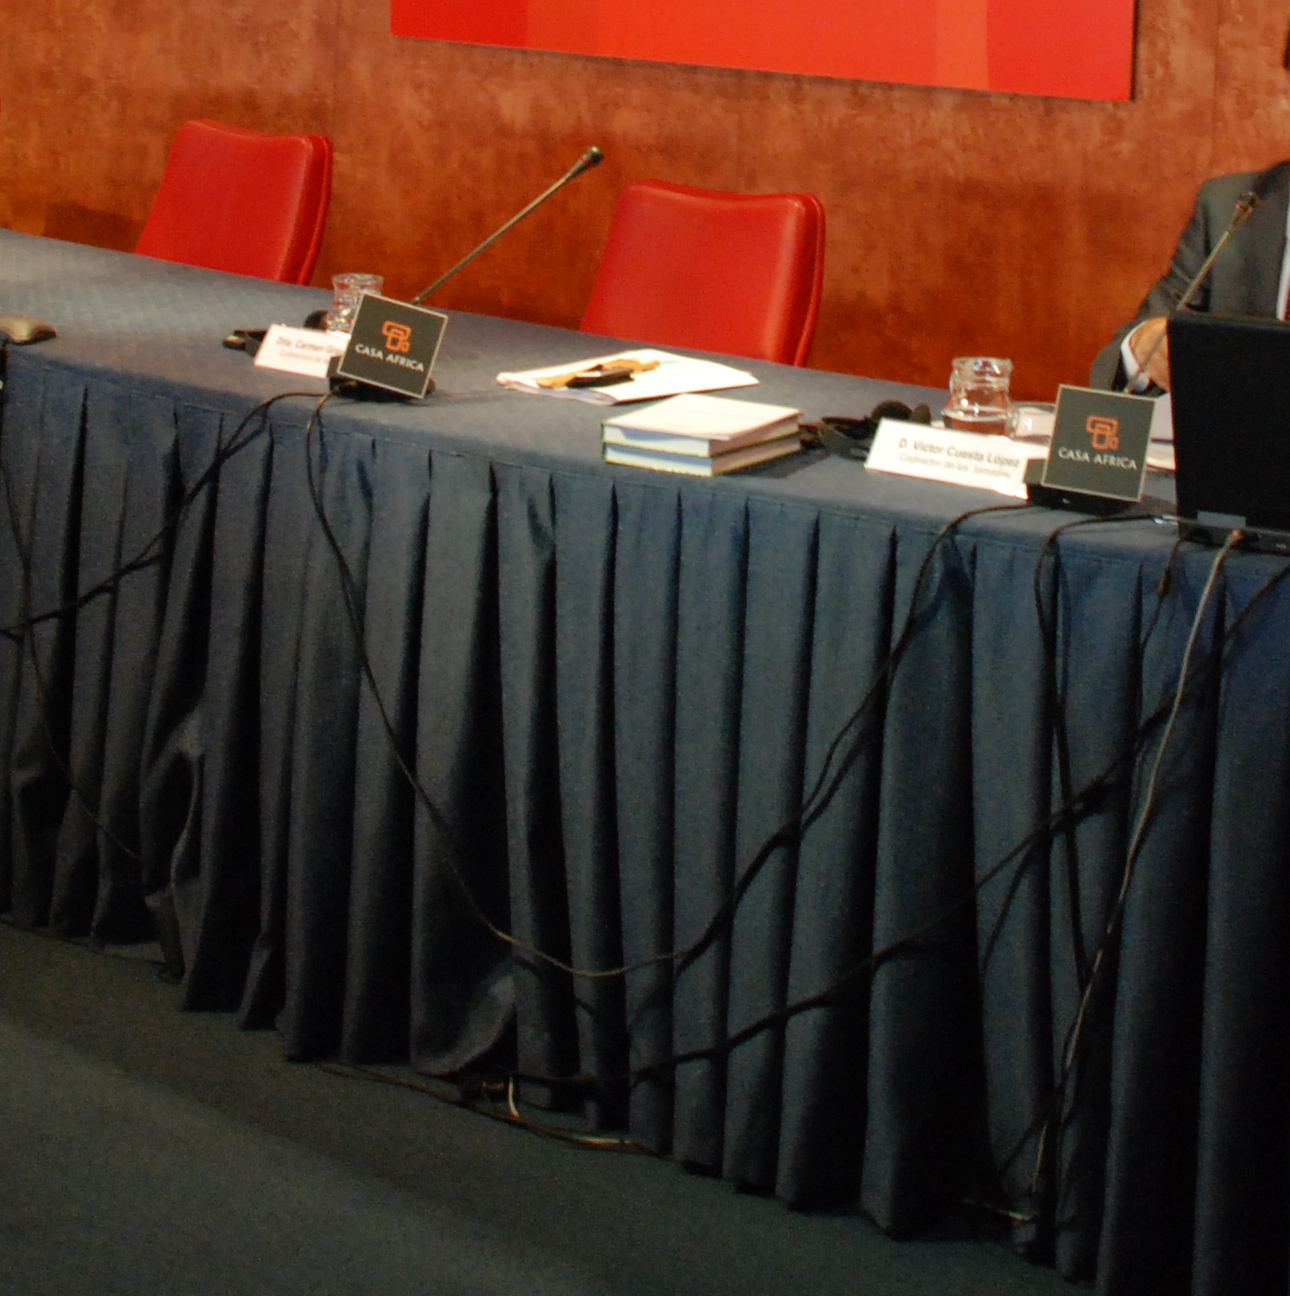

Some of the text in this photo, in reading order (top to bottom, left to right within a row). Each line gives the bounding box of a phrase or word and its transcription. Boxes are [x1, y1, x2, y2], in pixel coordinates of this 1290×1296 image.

[354, 342, 424, 373] CASA AFRICA
[946, 446, 984, 462] Cuesta
[986, 451, 1020, 468] López
[1057, 446, 1138, 472] CASA AFRICA
